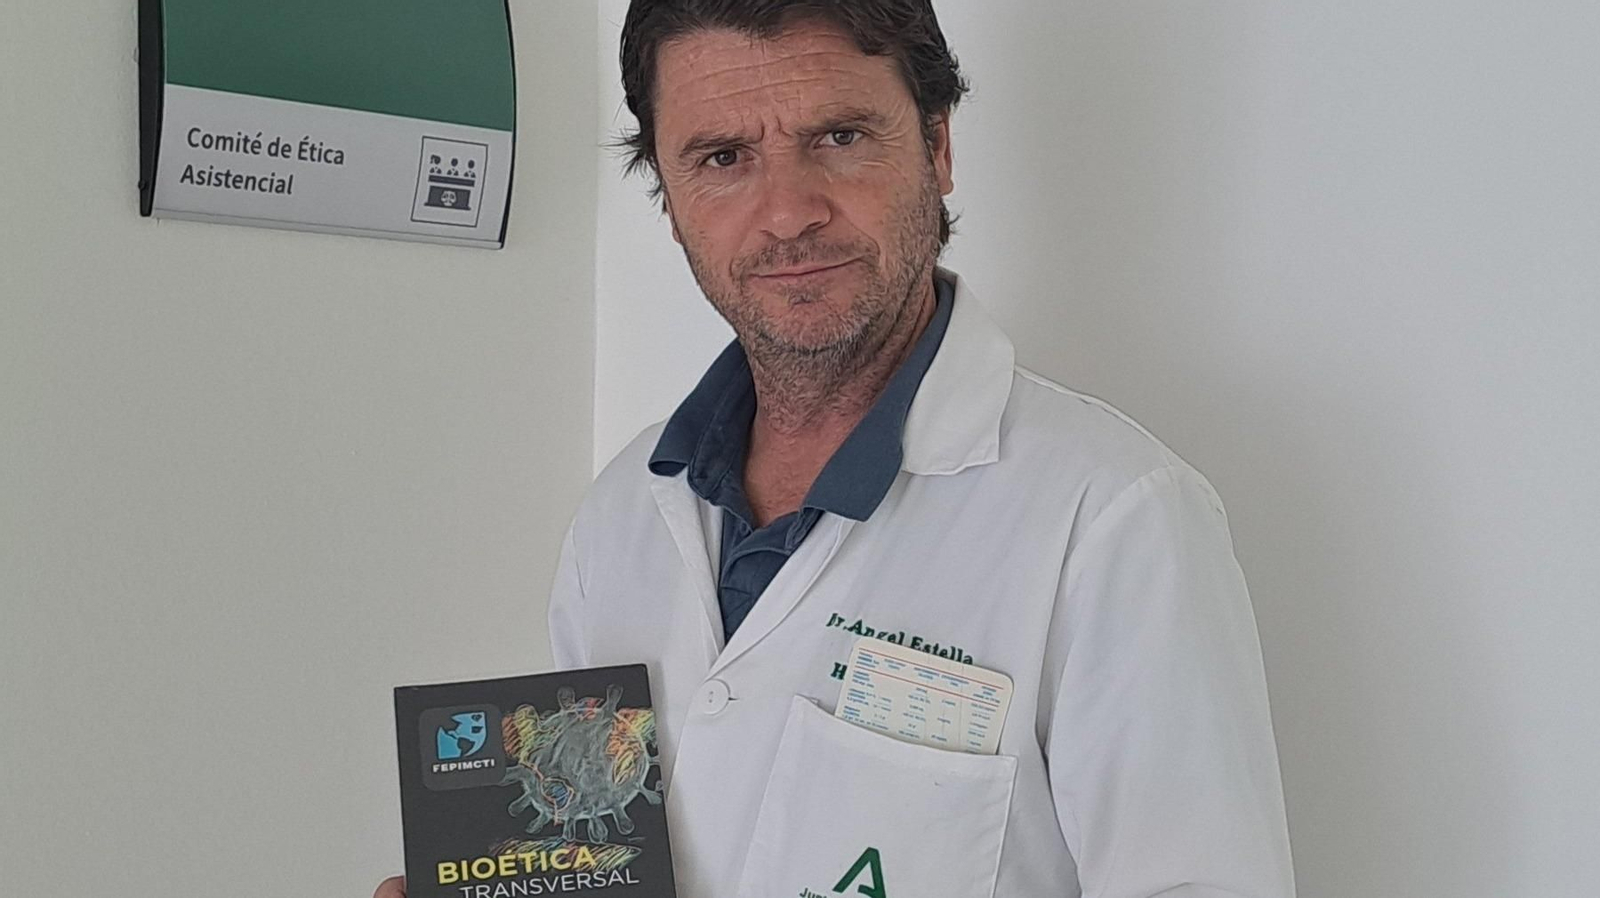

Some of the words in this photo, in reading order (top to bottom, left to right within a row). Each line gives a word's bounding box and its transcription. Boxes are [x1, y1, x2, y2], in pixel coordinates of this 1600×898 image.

[187, 127, 262, 155] Comité
[267, 137, 292, 159] de
[297, 136, 345, 165] Ética
[180, 164, 294, 195] Asistencial
[910, 636, 974, 666] Estella
[432, 758, 496, 773] FEPIMCTI
[437, 845, 597, 884] BIOÉTICA
[459, 868, 640, 898] TRANSVERSAL
